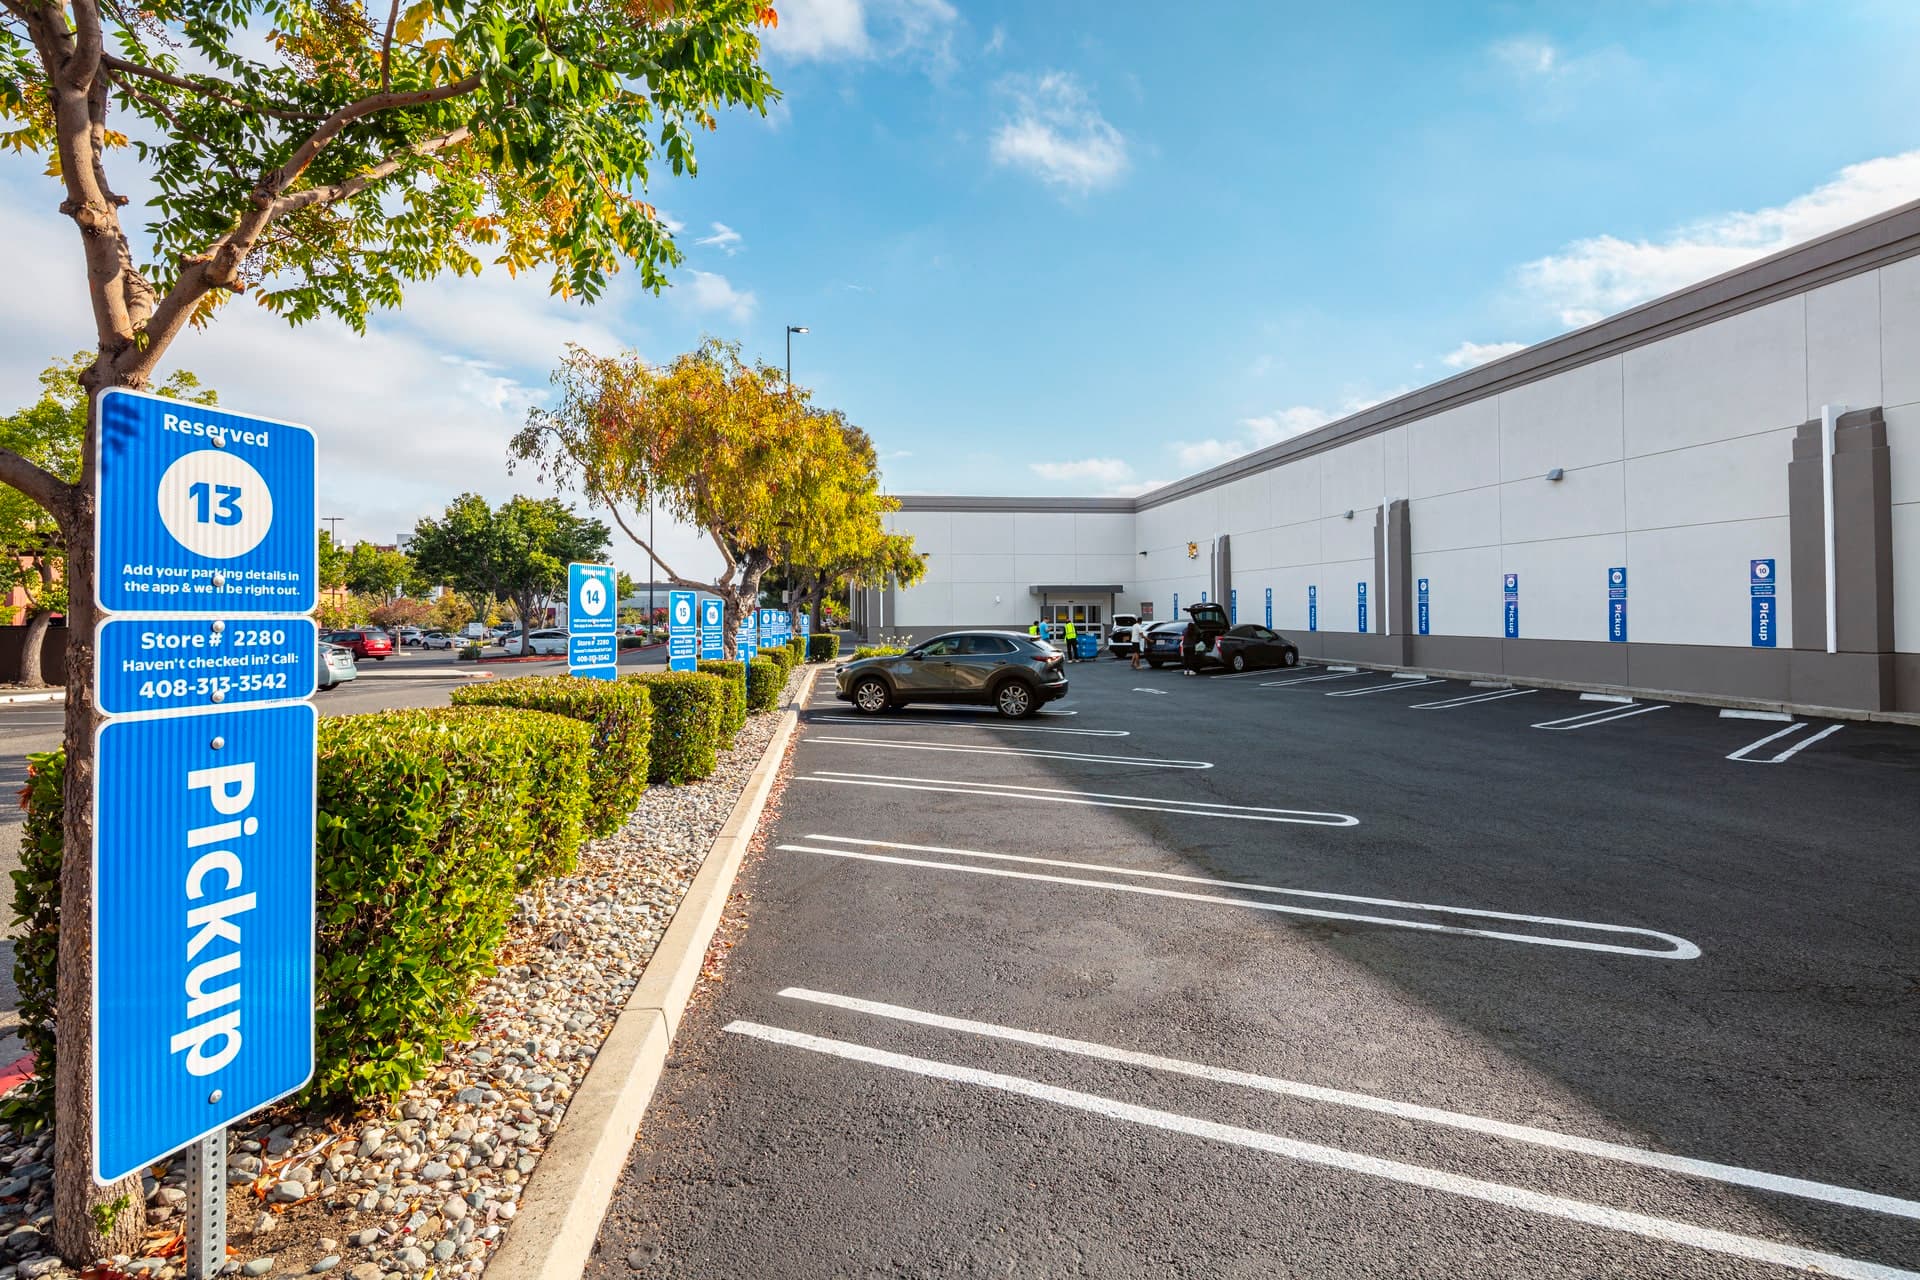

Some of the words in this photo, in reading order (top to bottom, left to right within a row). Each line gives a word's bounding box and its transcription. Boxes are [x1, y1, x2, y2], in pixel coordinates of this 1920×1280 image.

[163, 413, 269, 447] Reserved
[189, 481, 243, 526] 13
[122, 564, 153, 576] Add
[156, 567, 189, 578] your
[191, 568, 243, 580] parking
[245, 569, 286, 580] details
[288, 571, 300, 581] in
[124, 581, 150, 592] the
[152, 583, 180, 595] app
[182, 583, 191, 593] &
[194, 584, 224, 594] well
[226, 584, 243, 594] be
[245, 585, 275, 596] right
[277, 586, 300, 596] out.
[586, 589, 600, 604] 14
[679, 607, 687, 617] 15
[1614, 604, 1622, 637] Pickup
[1758, 602, 1769, 641] Pickup
[141, 632, 205, 650] Store
[209, 631, 222, 647] #
[234, 629, 285, 647] 2280
[122, 657, 186, 672] Haven't
[188, 655, 249, 669] checked
[251, 654, 270, 666] in?
[272, 653, 299, 665] Call:
[139, 673, 287, 699] 408-313-3542
[170, 761, 259, 1077] Pickup
